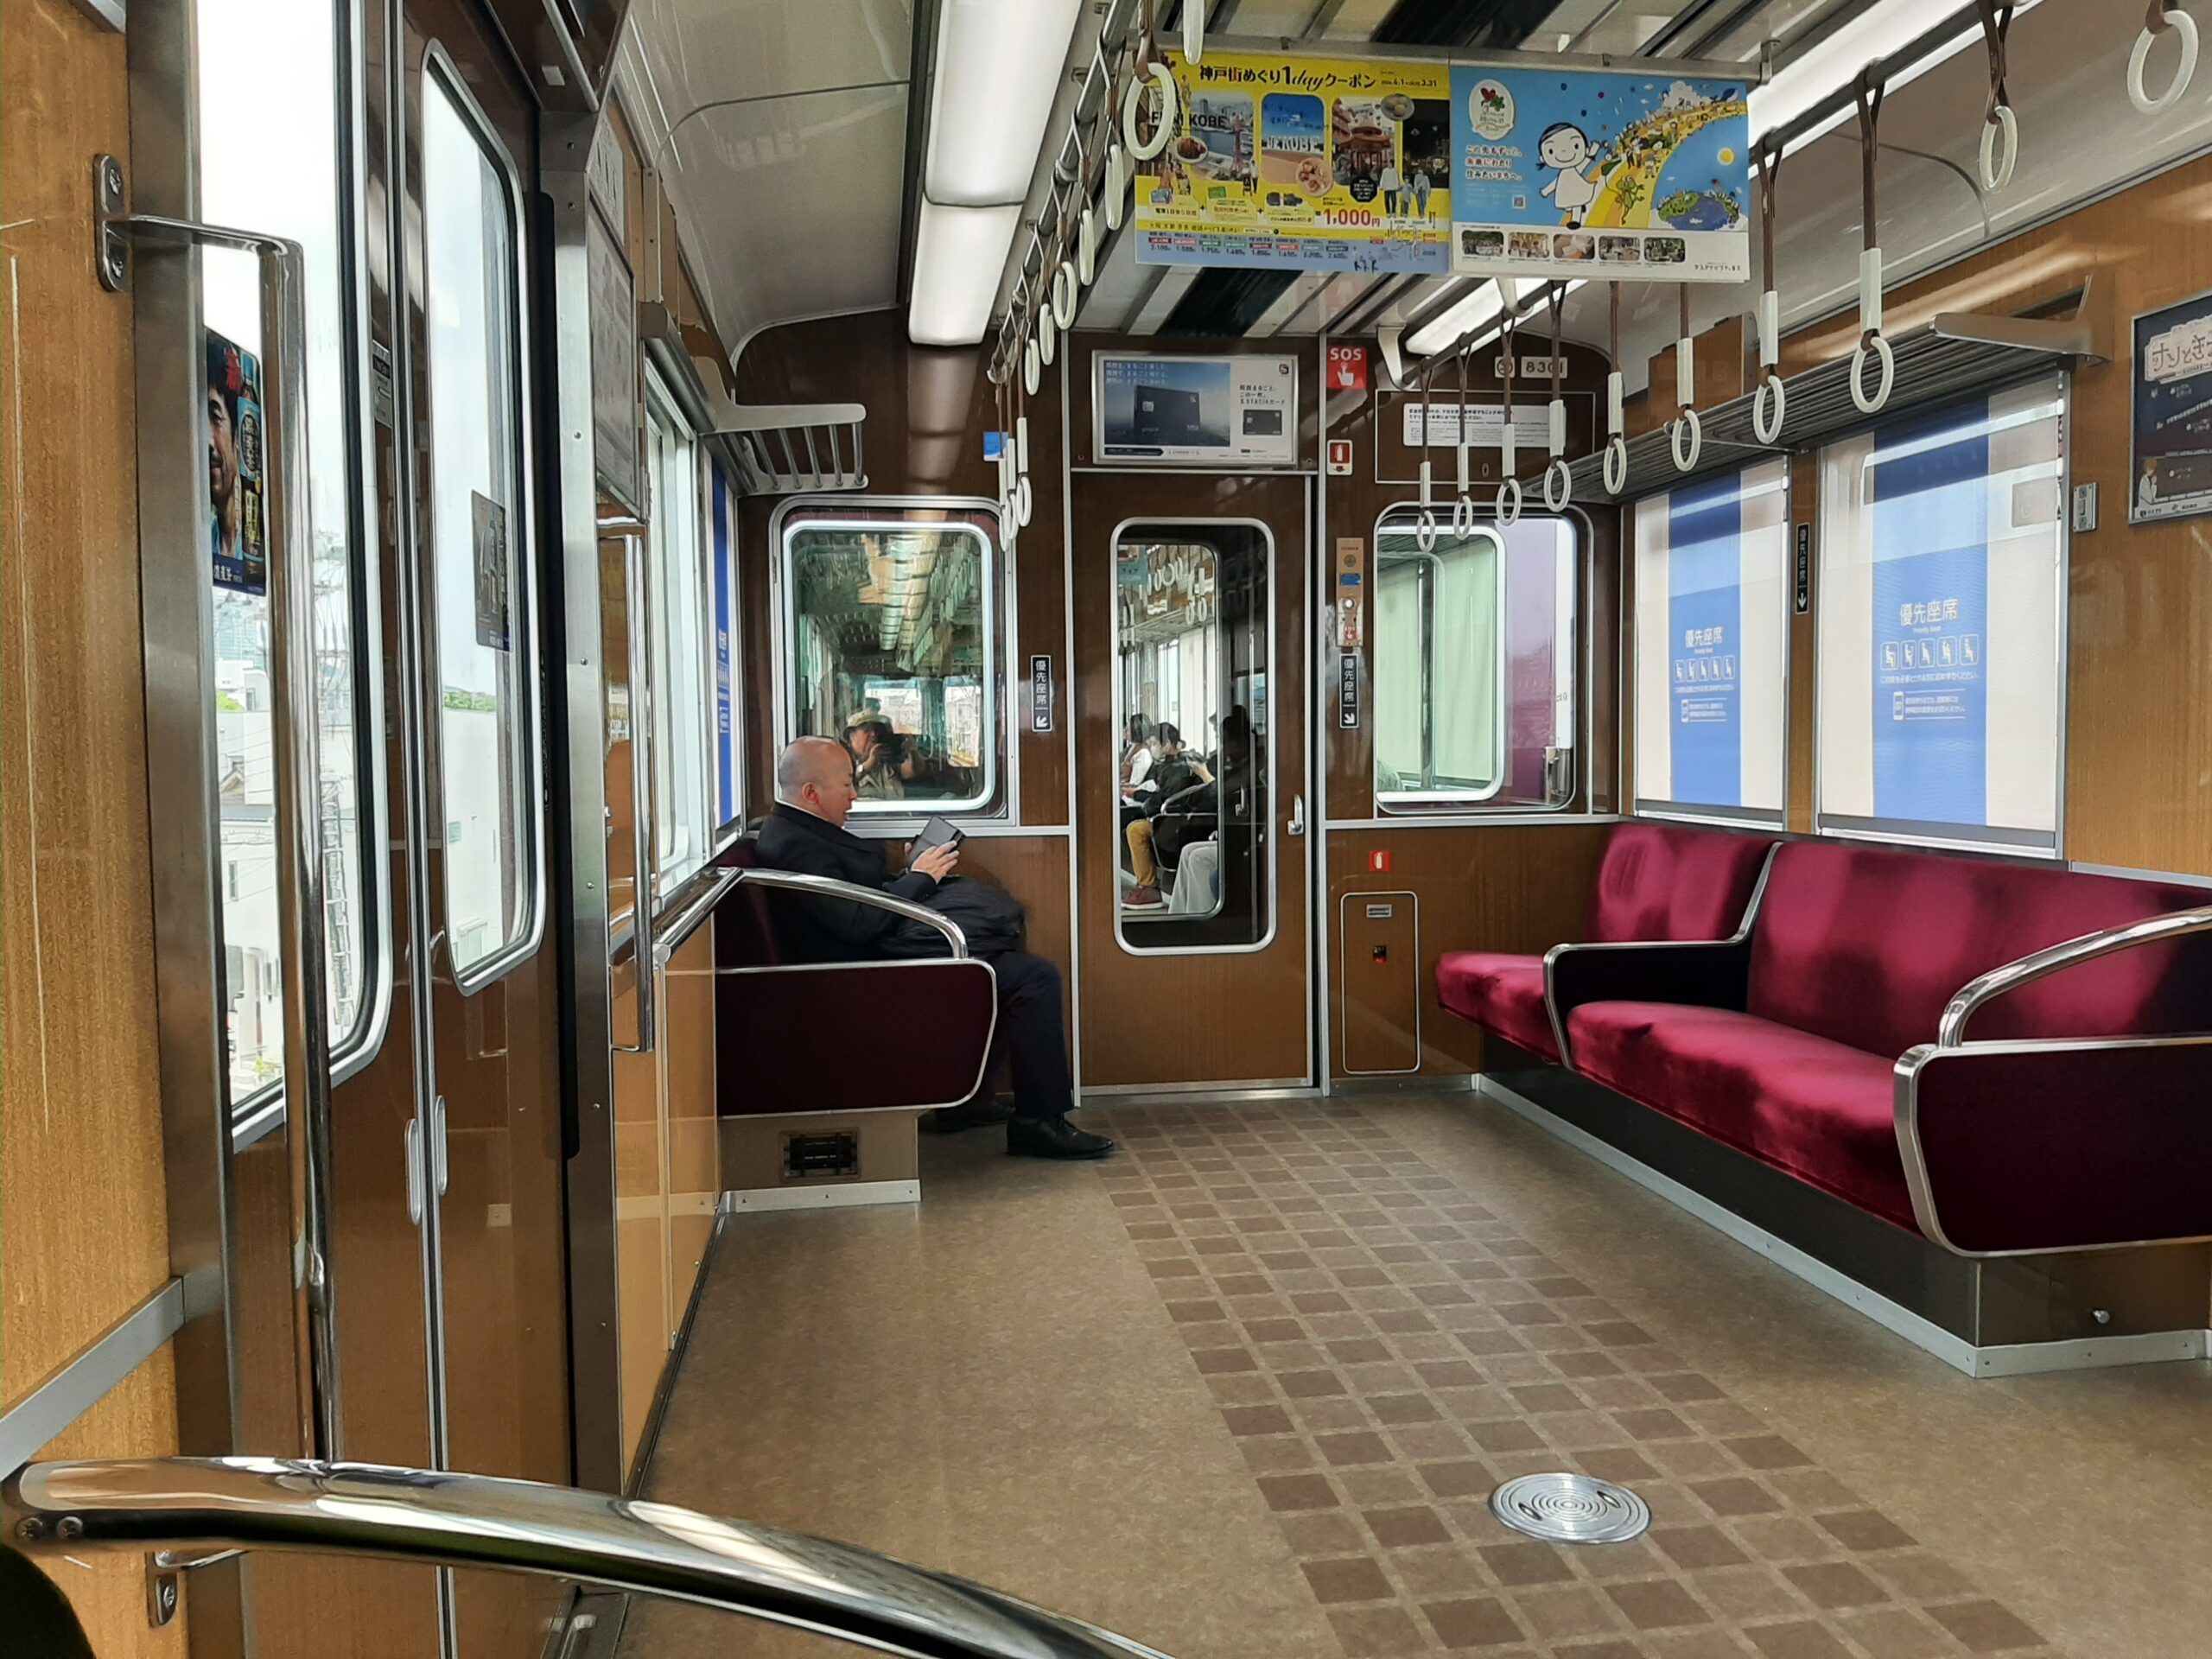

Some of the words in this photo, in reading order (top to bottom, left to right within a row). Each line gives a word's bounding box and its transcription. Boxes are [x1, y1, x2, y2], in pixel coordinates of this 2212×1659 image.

[1323, 208, 1381, 227] 1,000円
[1330, 347, 1362, 361] SOS
[1899, 598, 1959, 626] 優先座席
[1685, 626, 1723, 648] 優先座席
[1035, 659, 1047, 705] 優先座席
[1344, 658, 1355, 702] 優先座席
